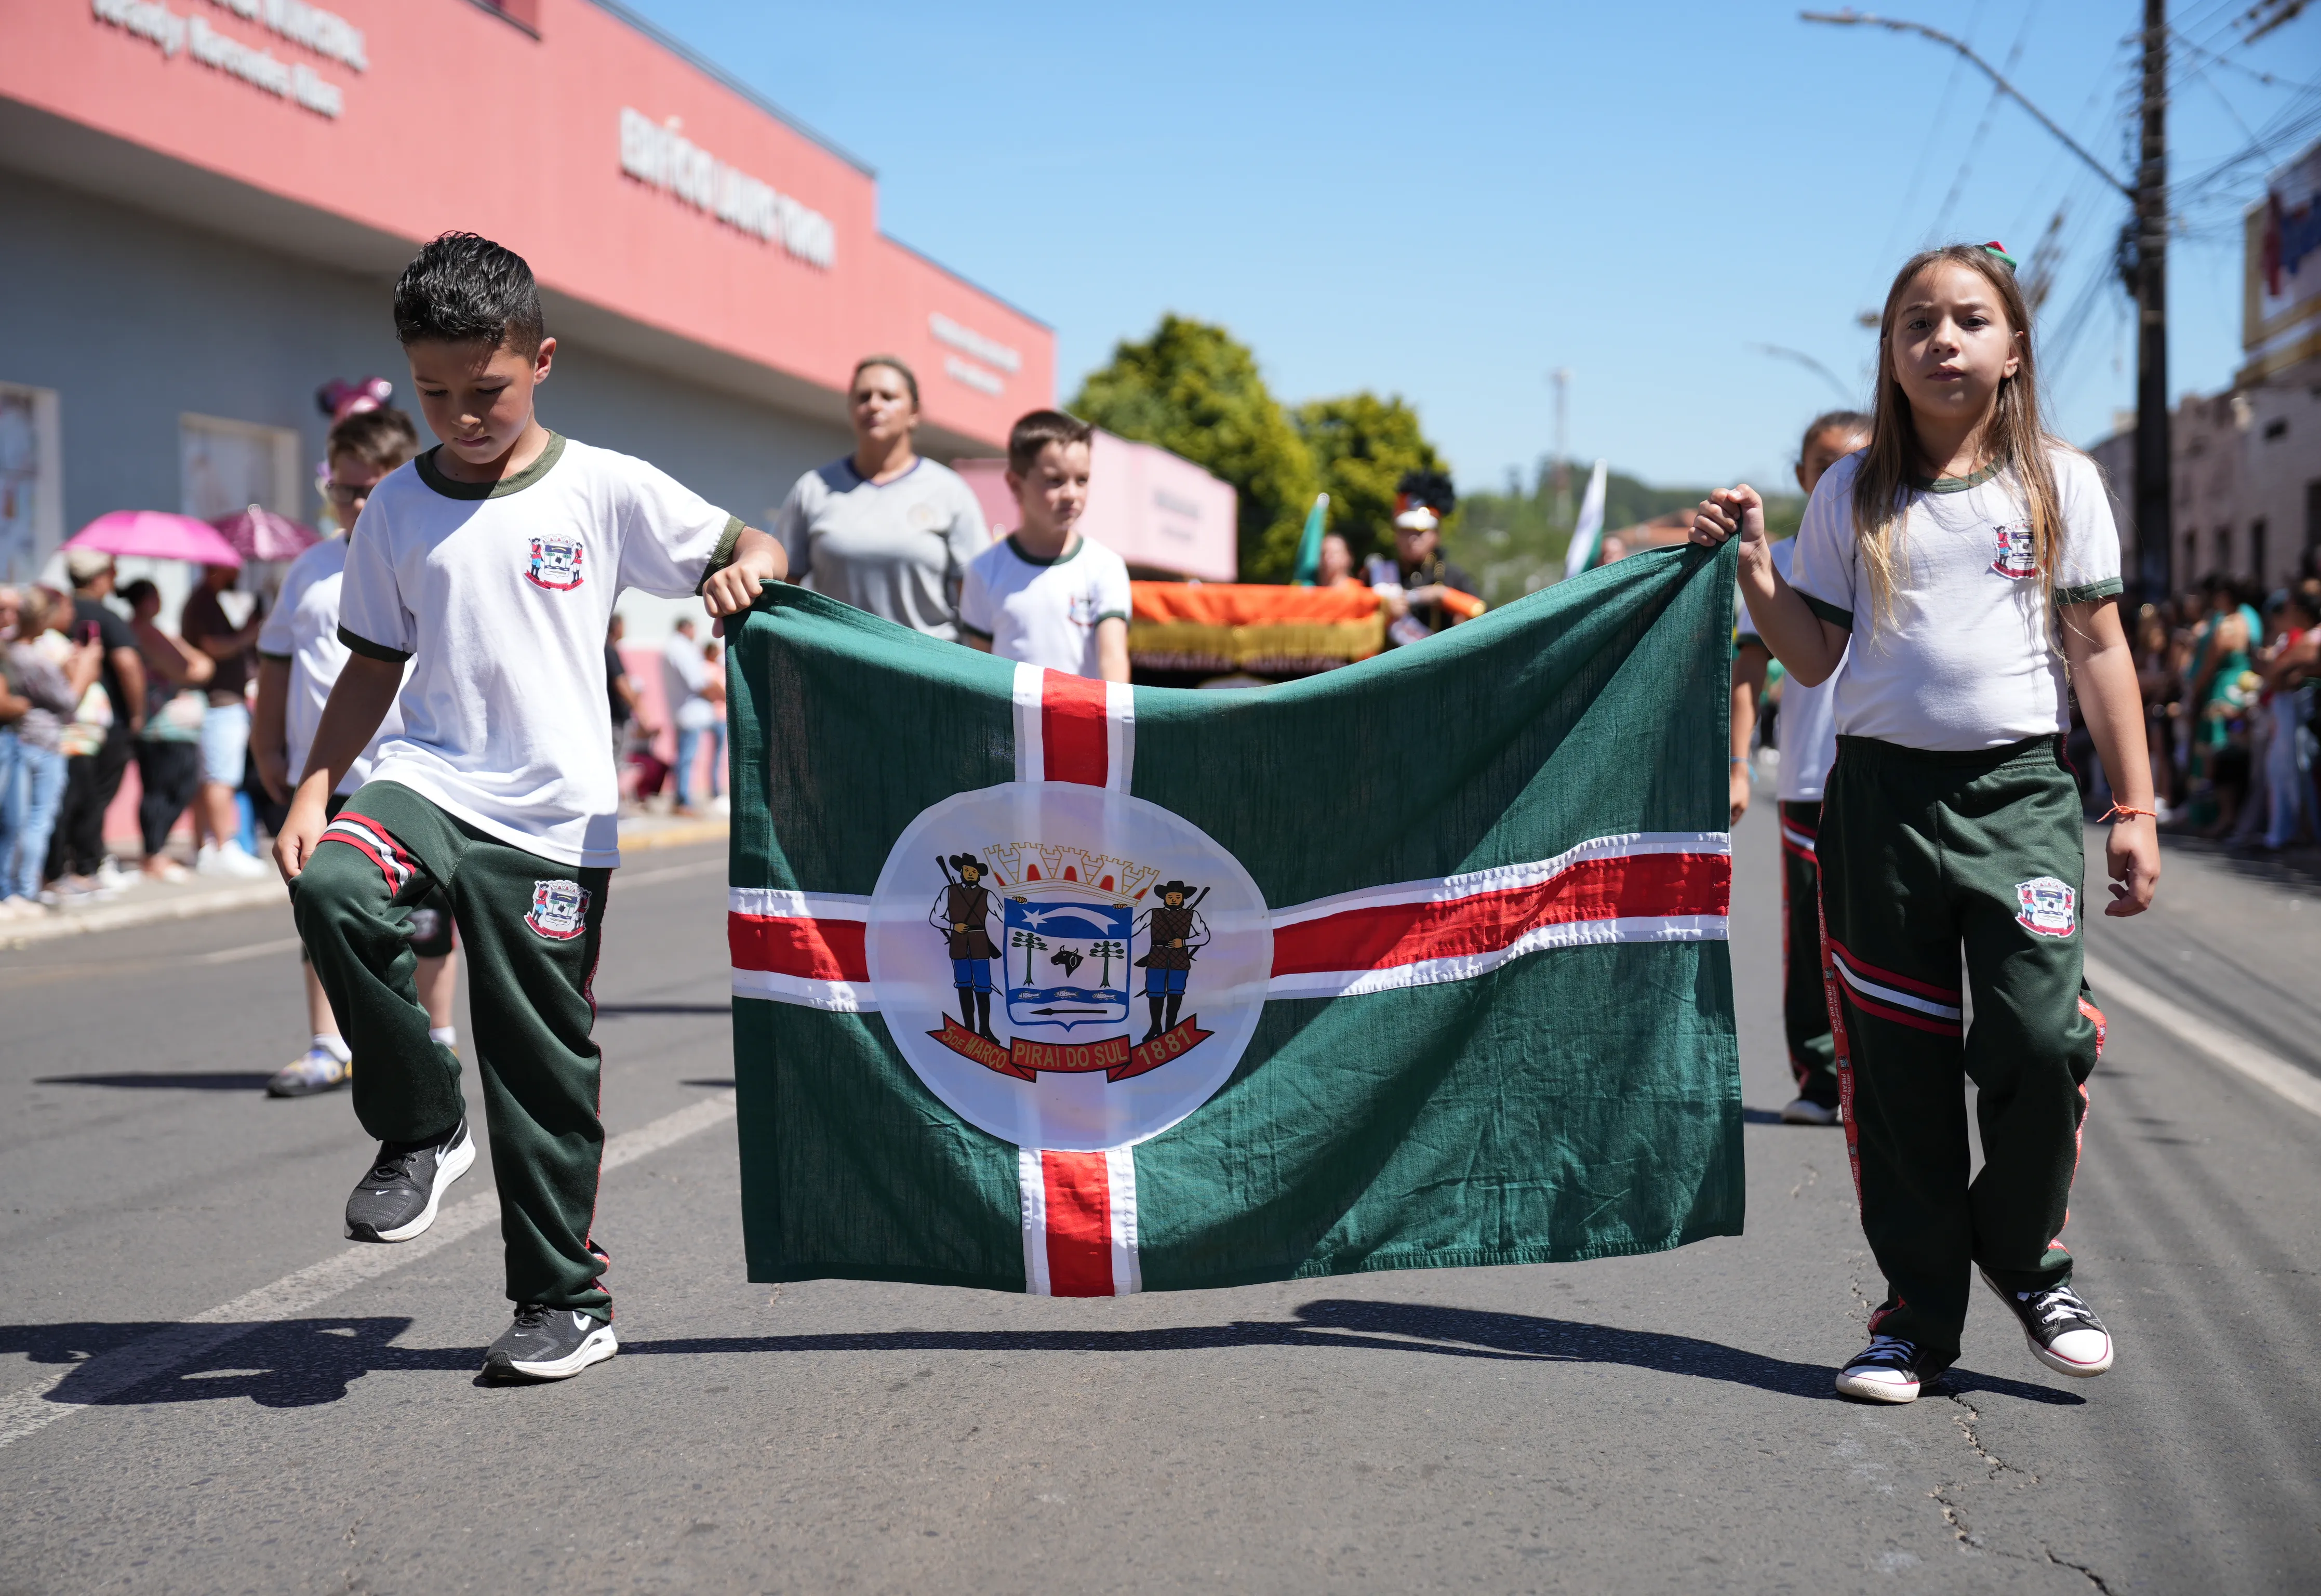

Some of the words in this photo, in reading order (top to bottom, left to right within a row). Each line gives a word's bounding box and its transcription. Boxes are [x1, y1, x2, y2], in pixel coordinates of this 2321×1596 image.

[1830, 1007, 1835, 1017] DO
[942, 1025, 956, 1042] 5
[949, 1036, 966, 1049] DE
[963, 1036, 1007, 1069] MARÇO
[1066, 1047, 1090, 1068] DO
[1094, 1042, 1128, 1066] SUL
[1138, 1026, 1191, 1065] 1881
[1842, 1095, 1847, 1105] DO
